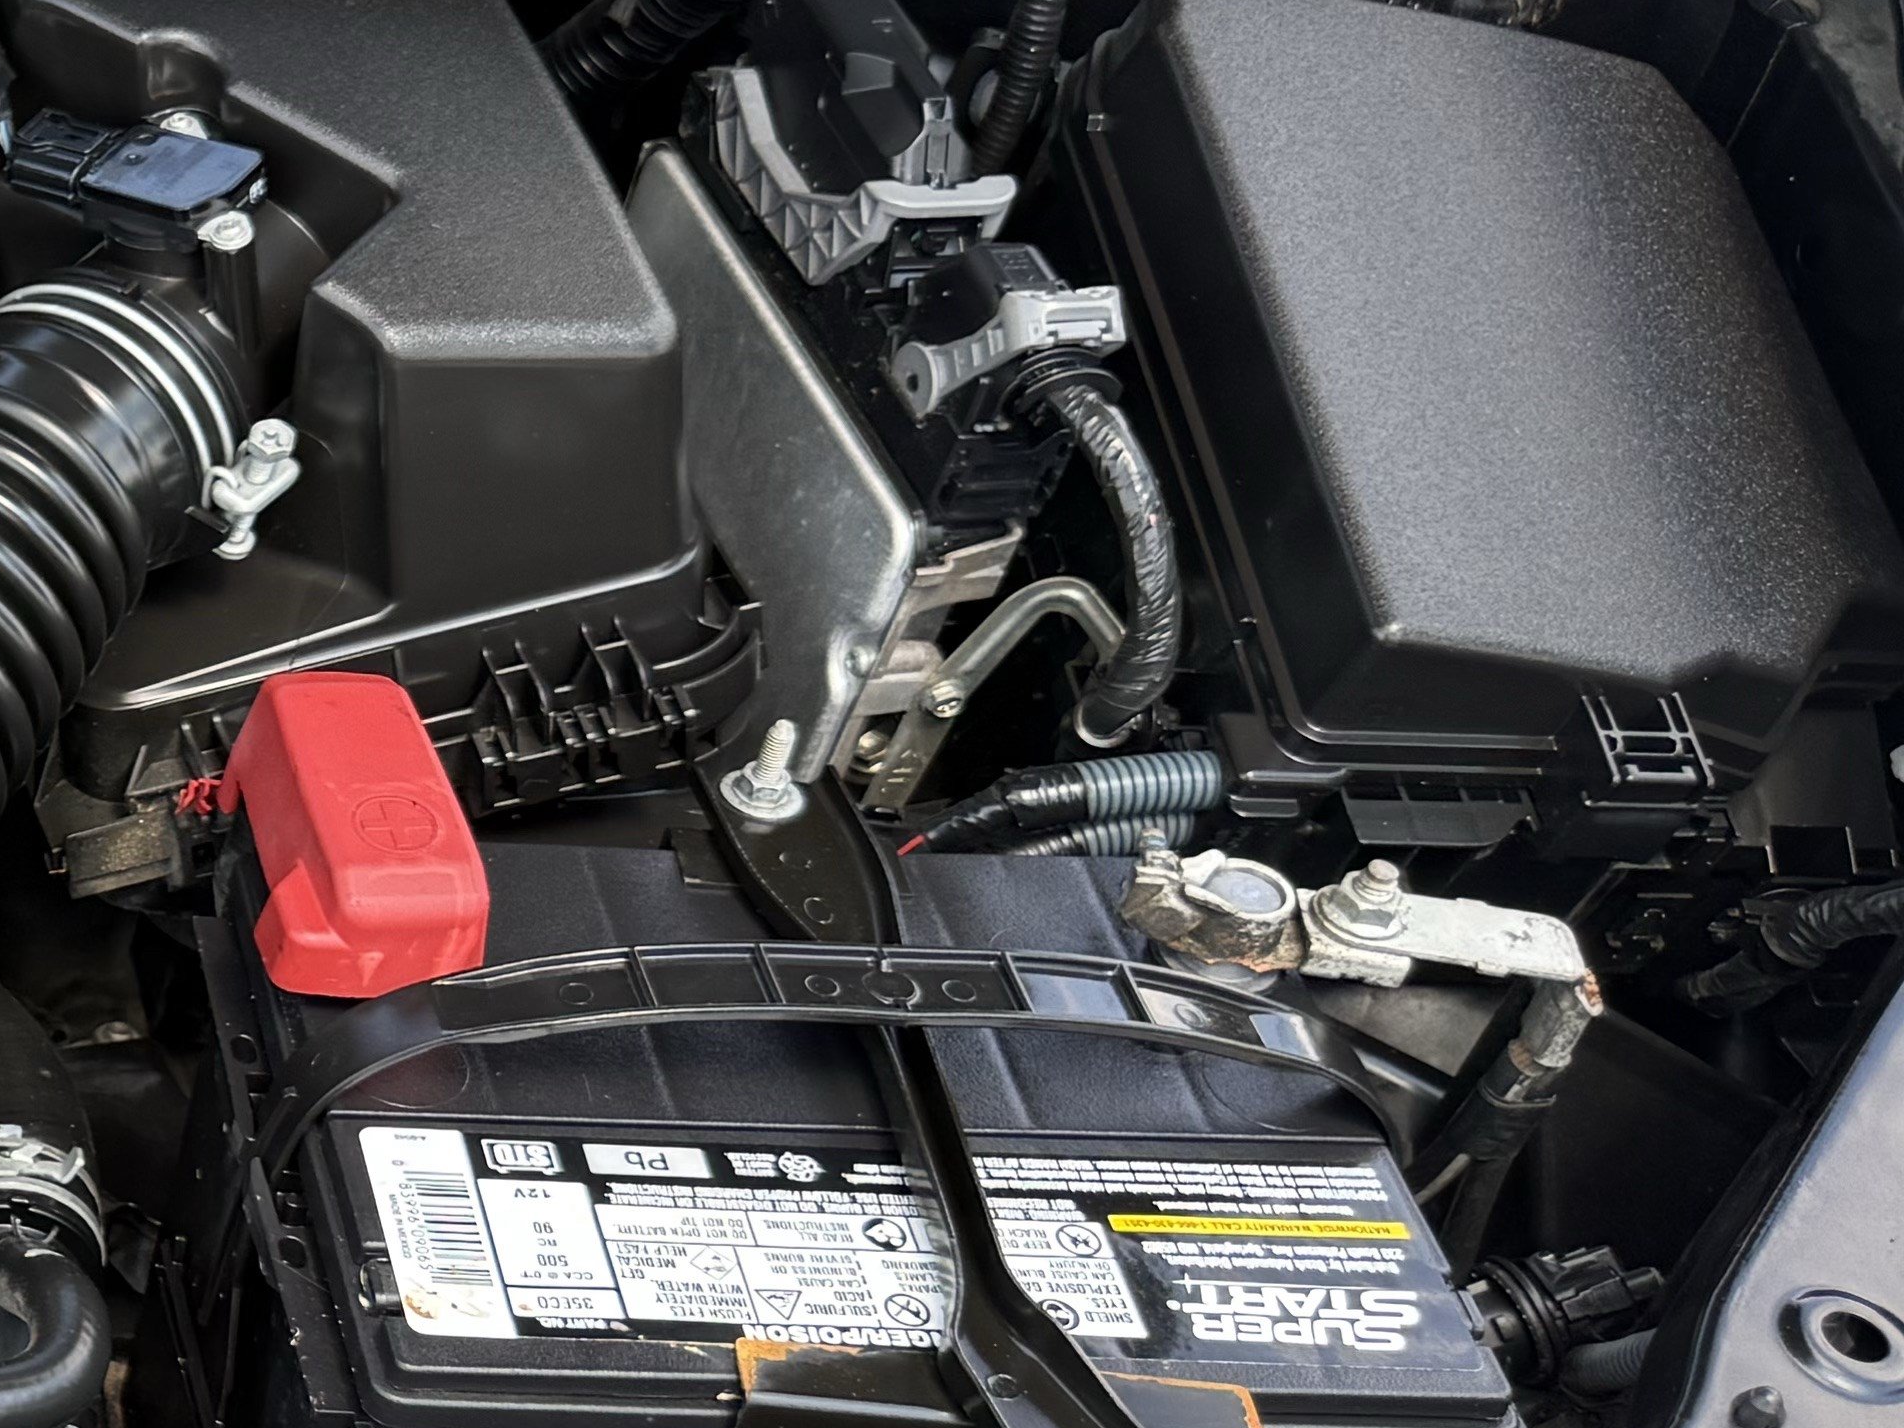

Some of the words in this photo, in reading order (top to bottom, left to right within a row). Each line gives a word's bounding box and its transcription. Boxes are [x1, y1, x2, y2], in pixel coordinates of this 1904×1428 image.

[623, 1151, 670, 1172] Pb
[513, 1188, 552, 1199] 12V
[536, 1253, 569, 1266] 500
[1181, 1285, 1421, 1326] START
[1083, 1311, 1134, 1324] SHIELD
[1191, 1313, 1406, 1351] SUPER
